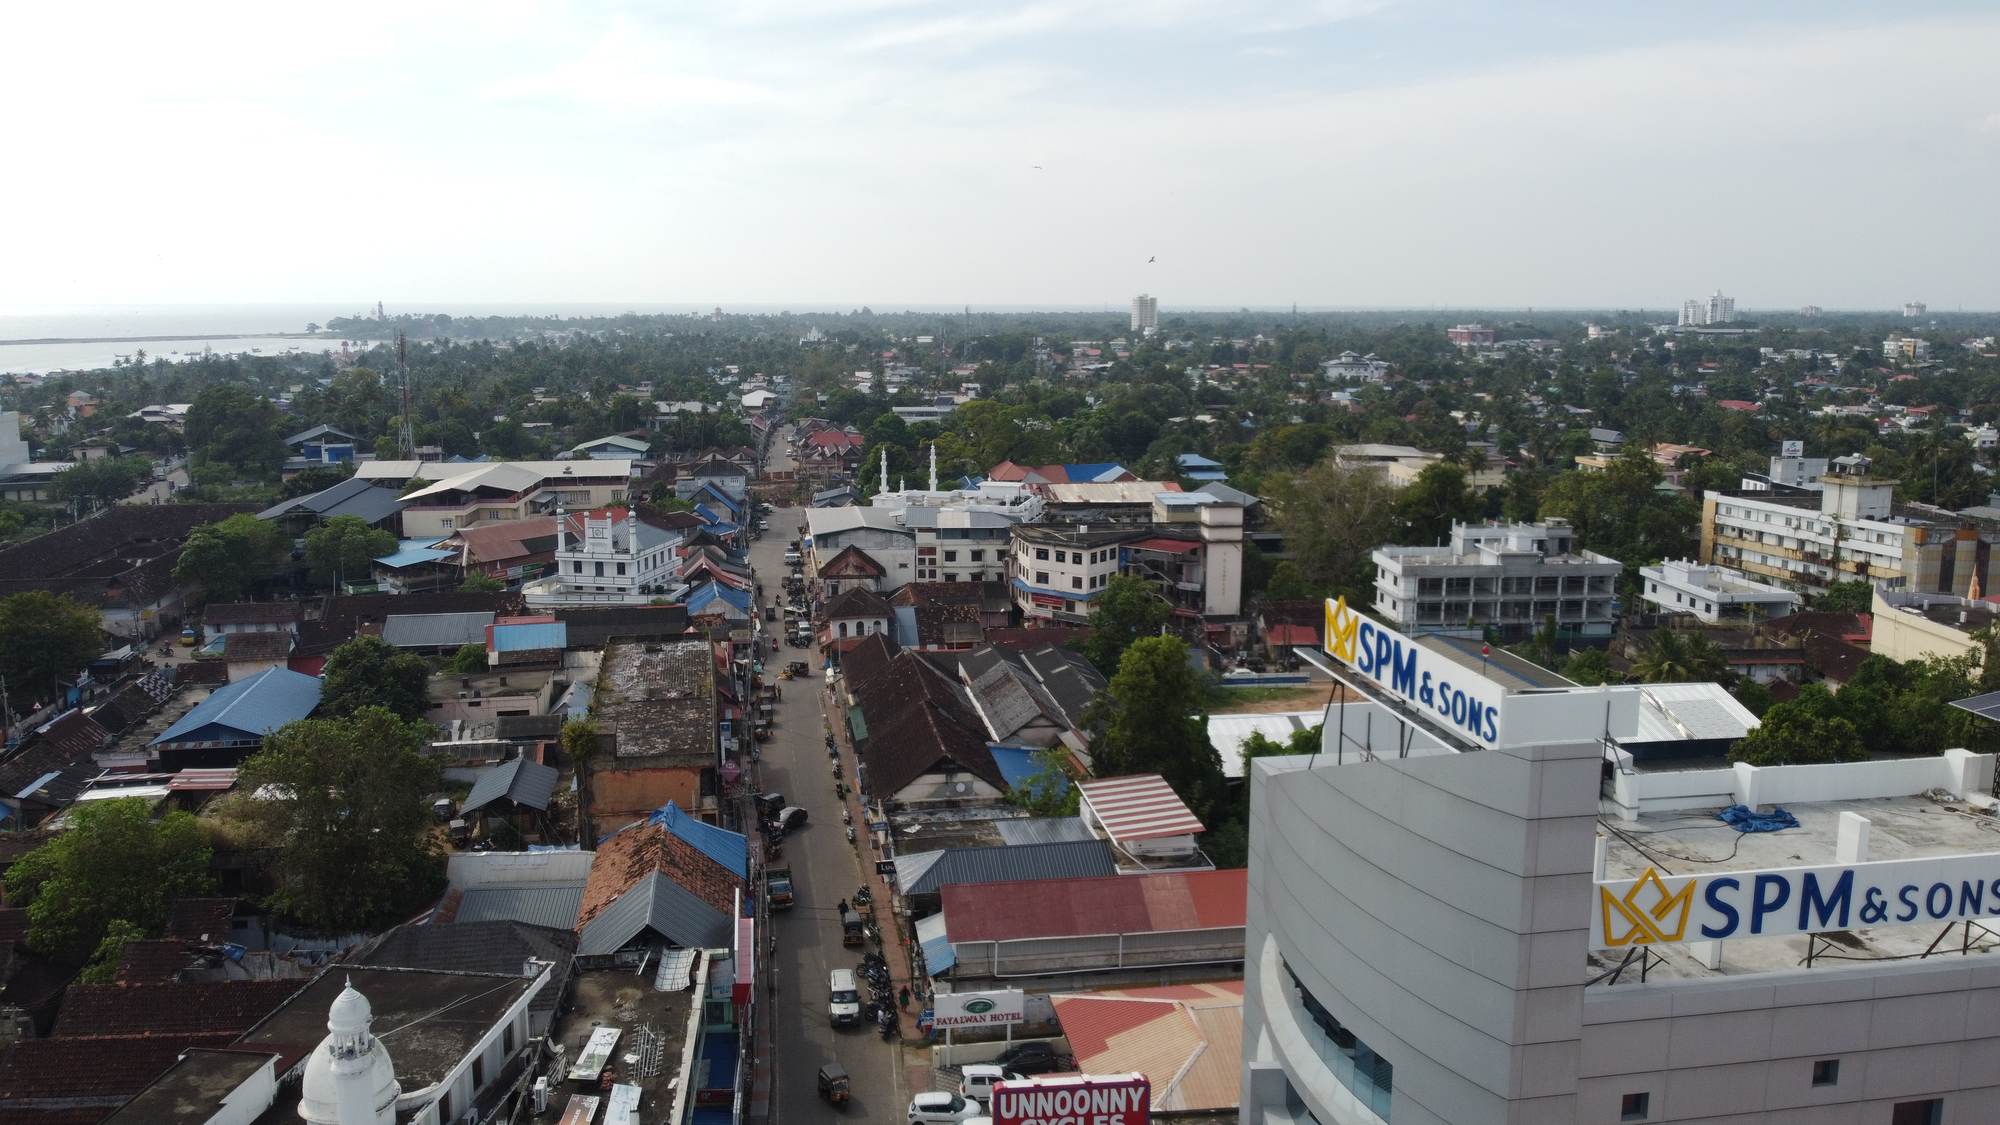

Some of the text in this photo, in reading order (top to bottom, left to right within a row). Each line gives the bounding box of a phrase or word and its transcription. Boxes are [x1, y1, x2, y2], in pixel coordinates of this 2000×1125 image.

[1358, 622, 1417, 700] SPM
[1438, 681, 1498, 743] SONS
[1701, 870, 1855, 939] SPM
[990, 1012, 1023, 1022] HOTEL
[1000, 1086, 1145, 1119] UNNOONNY
